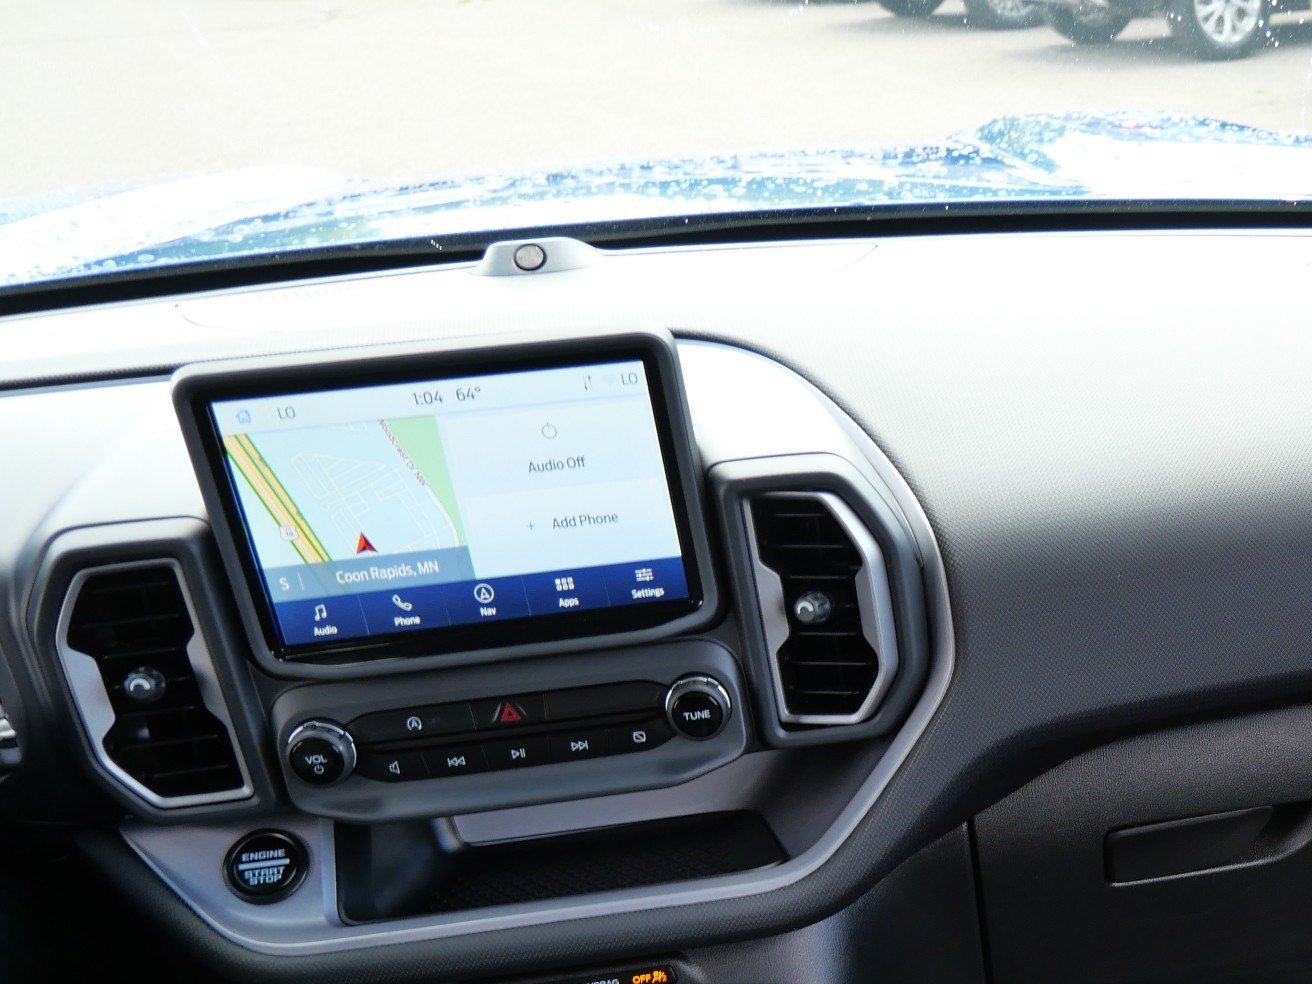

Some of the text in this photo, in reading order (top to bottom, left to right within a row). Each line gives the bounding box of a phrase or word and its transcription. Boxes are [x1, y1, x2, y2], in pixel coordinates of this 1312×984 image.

[620, 372, 638, 386] LO
[411, 387, 481, 406] 1:04 64°
[276, 406, 296, 420] LO
[528, 455, 586, 473] Audio Off
[552, 512, 619, 530] Add Phone
[279, 560, 440, 591] S Coon Rapids, MN
[631, 585, 665, 600] Settings
[558, 596, 579, 609] Apps
[480, 606, 496, 617] Nav
[394, 615, 421, 627] Phone
[314, 623, 338, 637] Audio
[682, 708, 712, 723] TUNE
[305, 754, 327, 768] VOL
[241, 848, 286, 862] ENGINE
[244, 865, 286, 880] START
[249, 873, 282, 886] STOP
[632, 971, 652, 984] OFF
